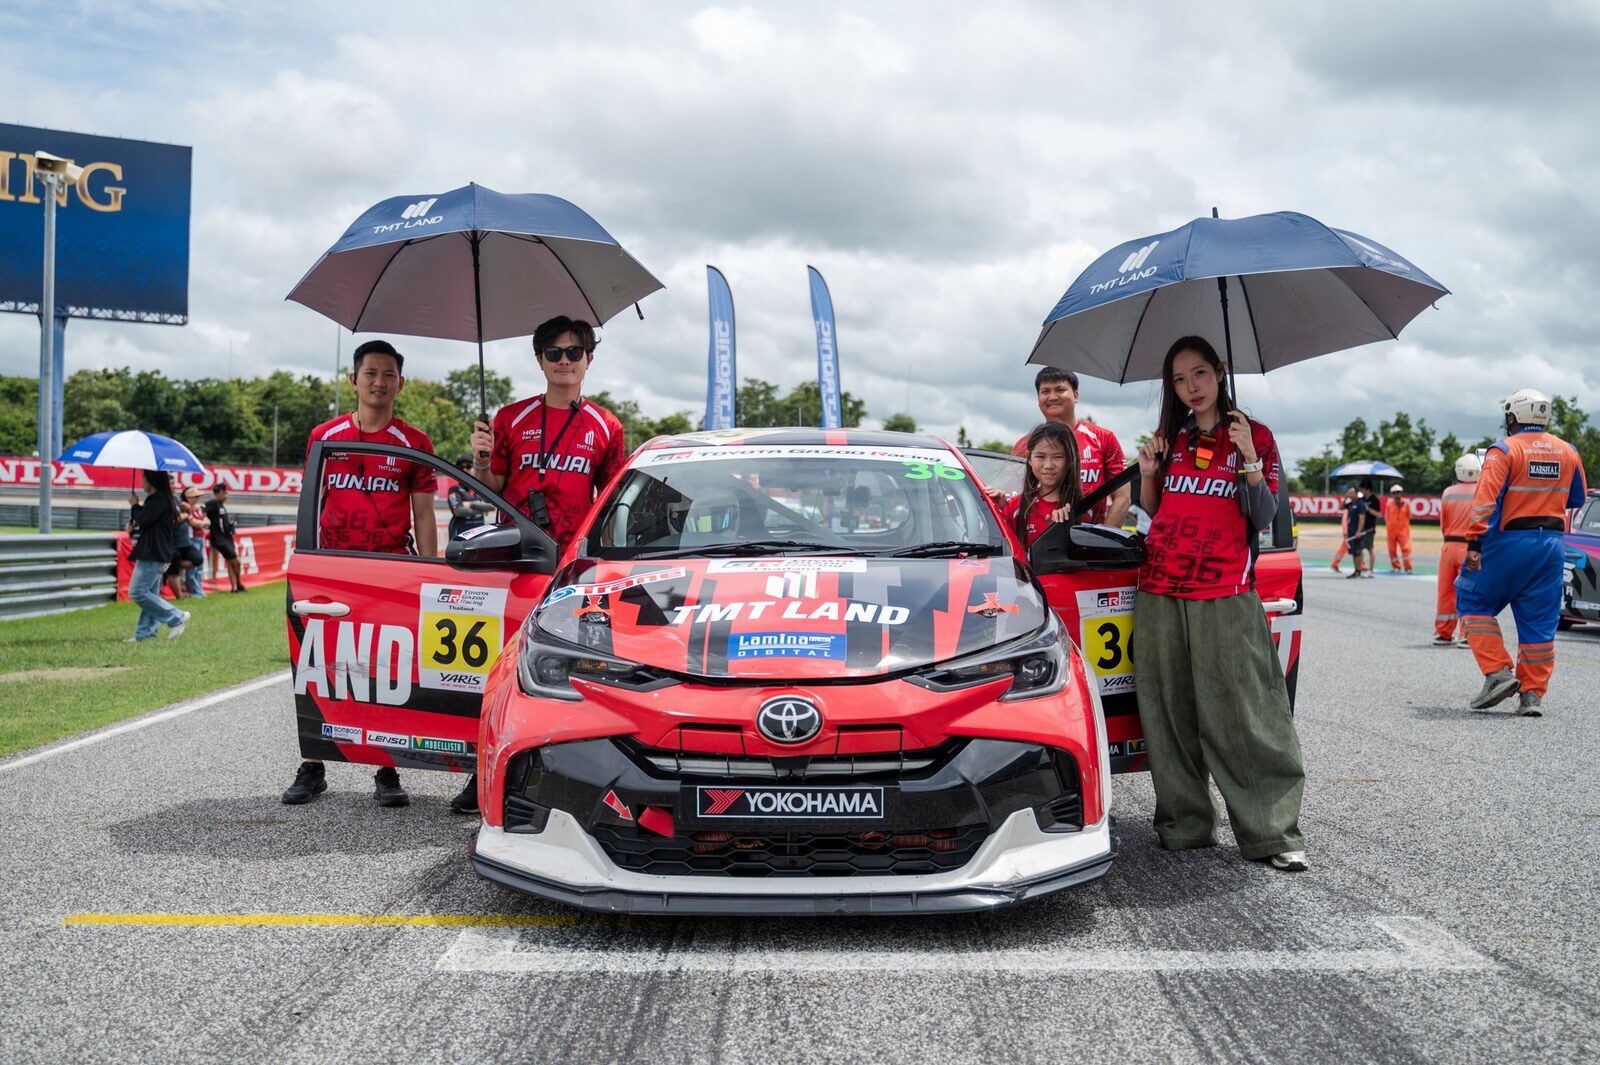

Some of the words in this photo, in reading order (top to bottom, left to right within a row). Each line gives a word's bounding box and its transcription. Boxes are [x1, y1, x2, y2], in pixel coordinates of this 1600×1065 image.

[373, 221, 404, 234] TMT
[404, 215, 444, 229] LAND
[1090, 277, 1120, 295] TMT
[1118, 266, 1158, 286] LAND
[698, 449, 781, 457] TOYOTA
[870, 451, 941, 462] Racing
[902, 461, 966, 480] 36
[1530, 465, 1558, 475] MARSHAL
[1168, 553, 1224, 584] 36
[672, 601, 777, 625] TMT
[781, 601, 911, 626] LAND
[432, 618, 488, 668] 36
[739, 633, 808, 646] Lamina
[294, 618, 414, 706] AND
[738, 649, 831, 657] DIGITAL
[368, 734, 407, 745] LENSO
[424, 740, 461, 752] MODELLISTA
[745, 793, 878, 813] YOKOHAMA
